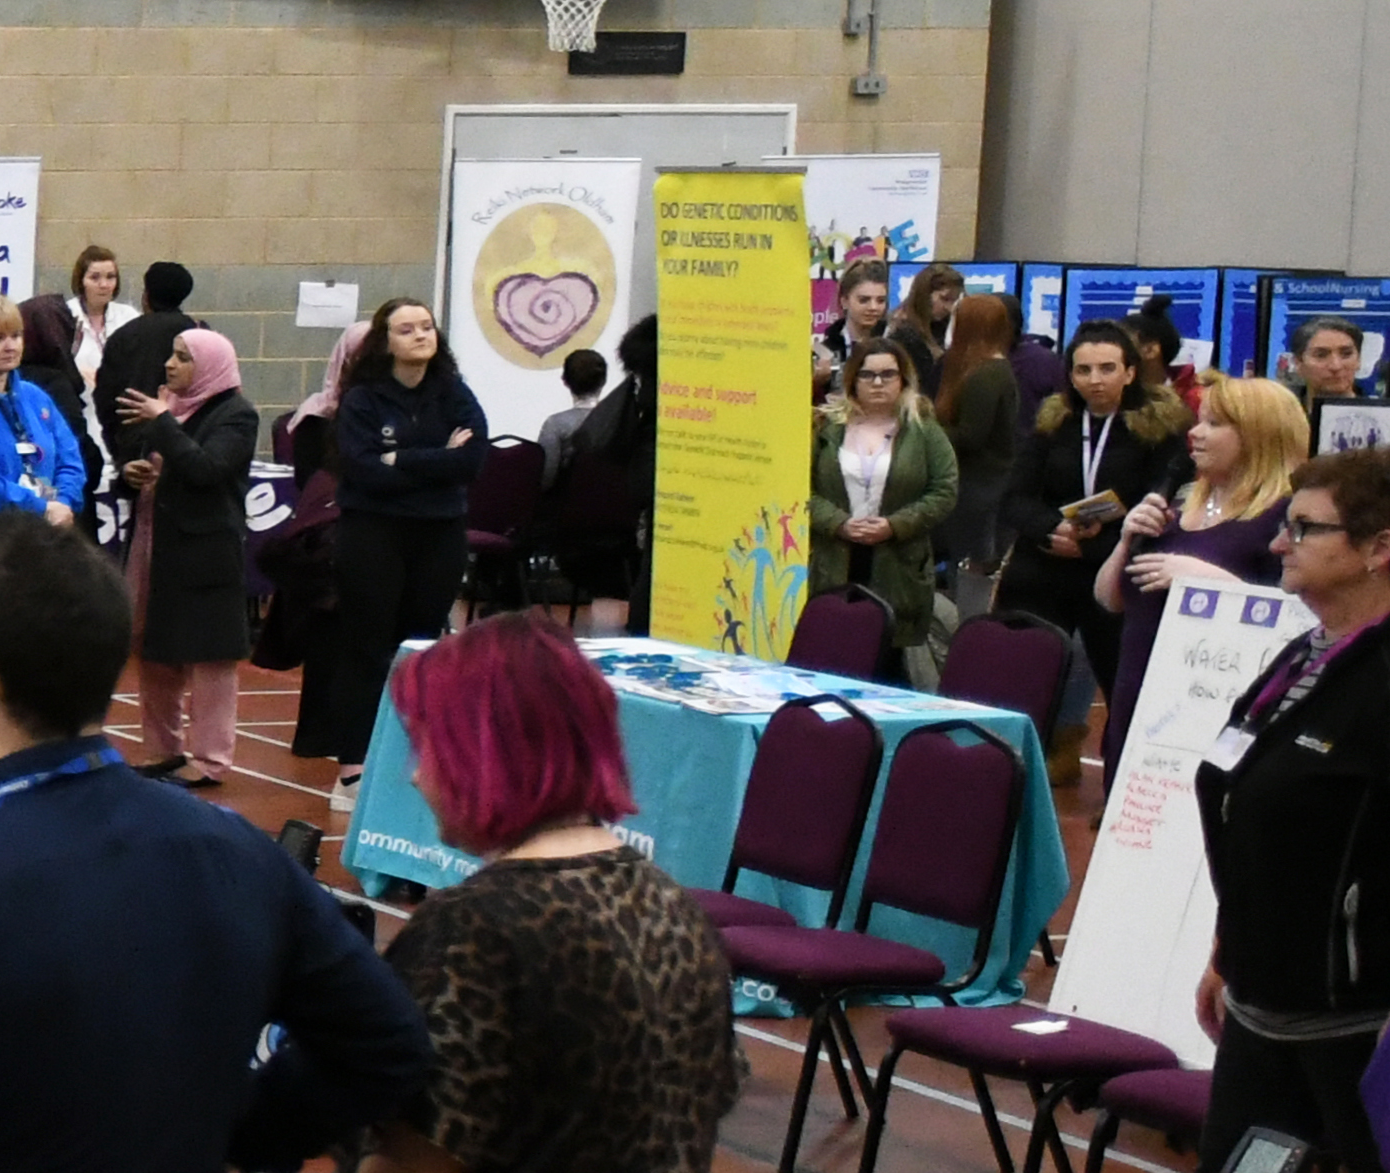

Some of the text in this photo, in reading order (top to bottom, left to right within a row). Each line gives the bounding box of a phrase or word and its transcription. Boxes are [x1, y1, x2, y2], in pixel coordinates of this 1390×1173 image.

[471, 182, 615, 225] Reiki Network Oldham
[660, 202, 799, 222] DO GENETIC CONDITIONS
[661, 230, 773, 250] OR ILLNESSES RUN IN
[691, 259, 739, 277] FAMILY?
[1183, 637, 1242, 674] WATER
[358, 828, 454, 873] ommunity
